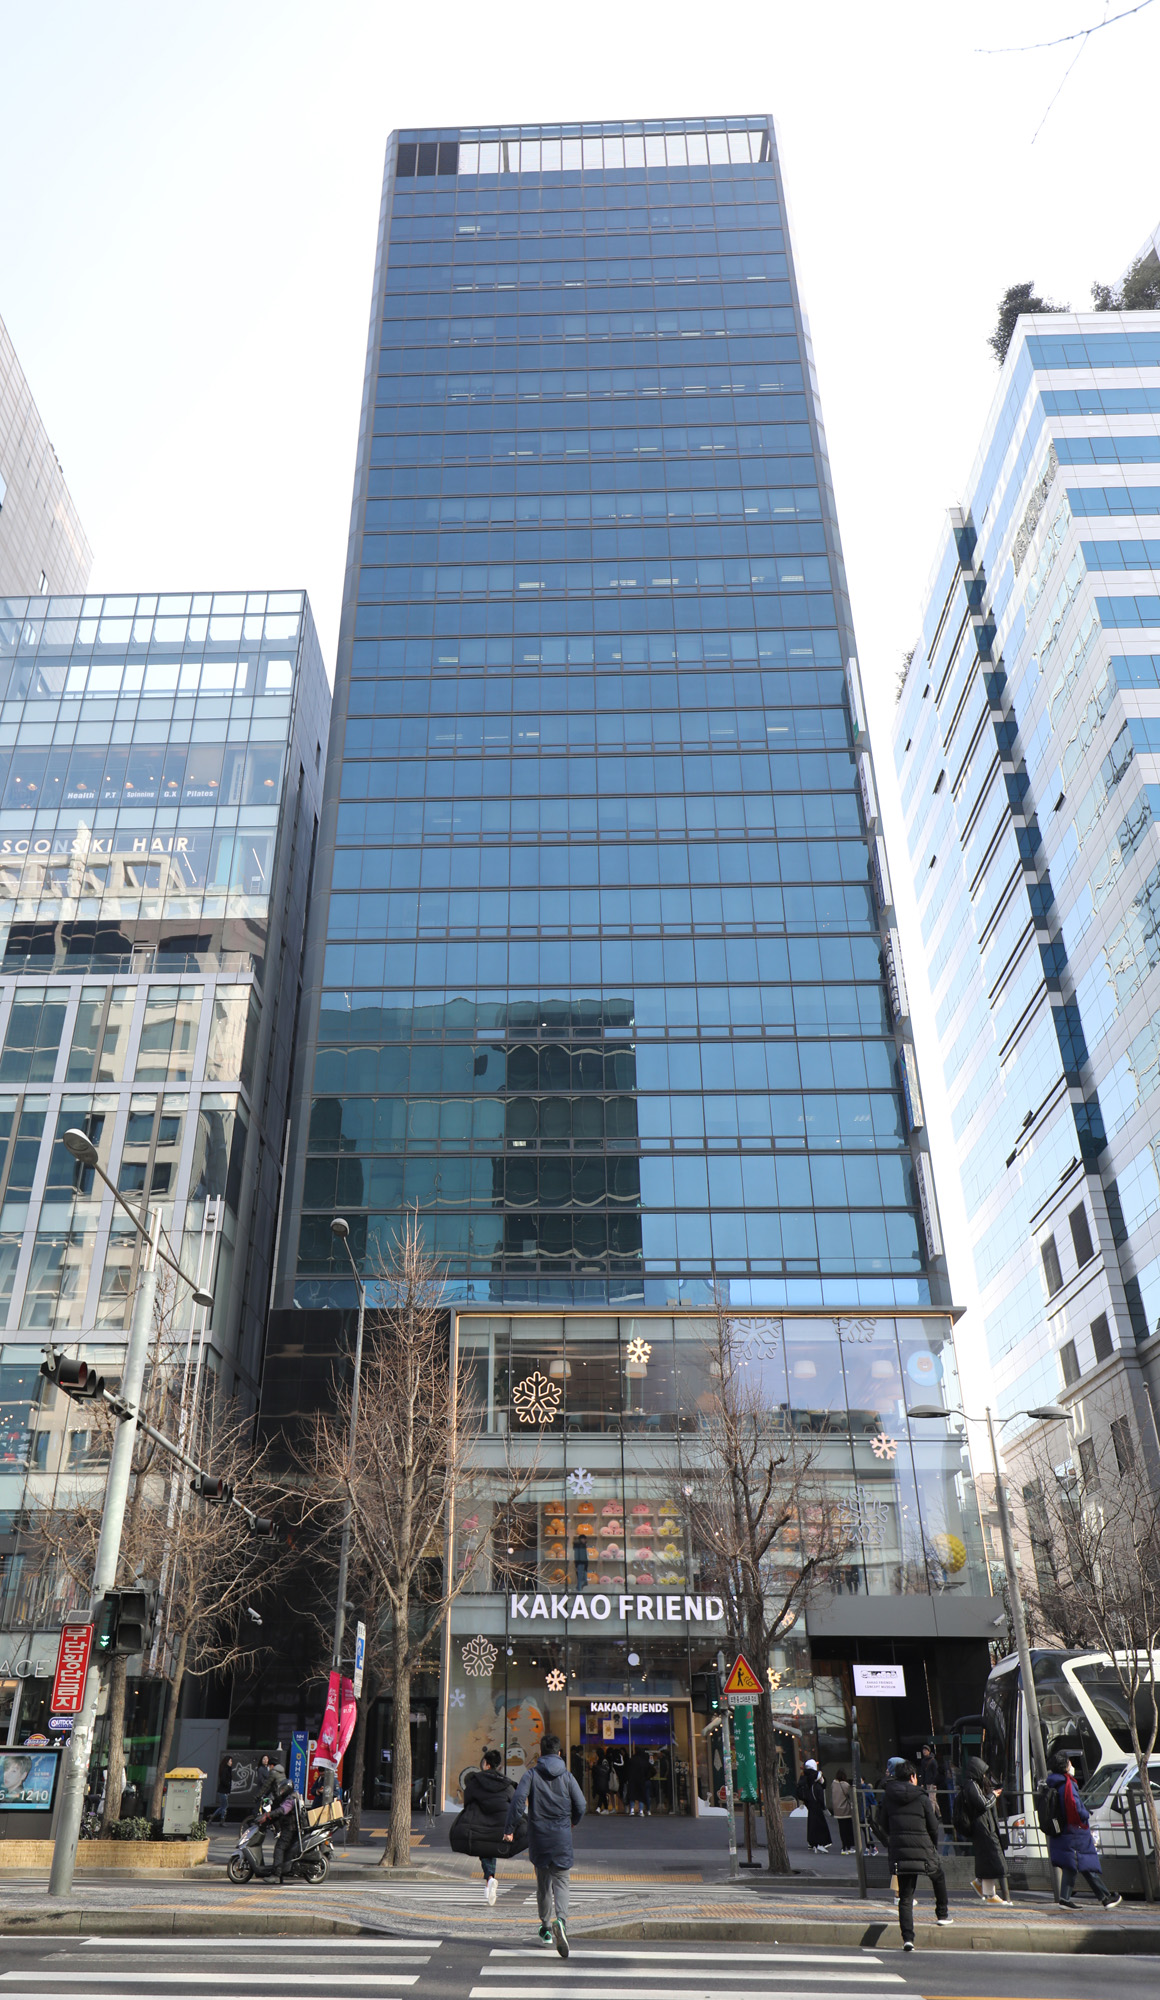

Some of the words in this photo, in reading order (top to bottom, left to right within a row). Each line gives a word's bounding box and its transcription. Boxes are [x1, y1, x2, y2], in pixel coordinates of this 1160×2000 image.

[132, 837, 188, 852] HAIR
[510, 1593, 612, 1620] KAKAO
[0, 1659, 51, 1678] ACE
[55, 1628, 88, 1710] 무단횡단금지
[590, 1702, 625, 1713] KAKAO
[626, 1703, 669, 1713] FRIENDS
[20, 1790, 49, 1801] 1210
